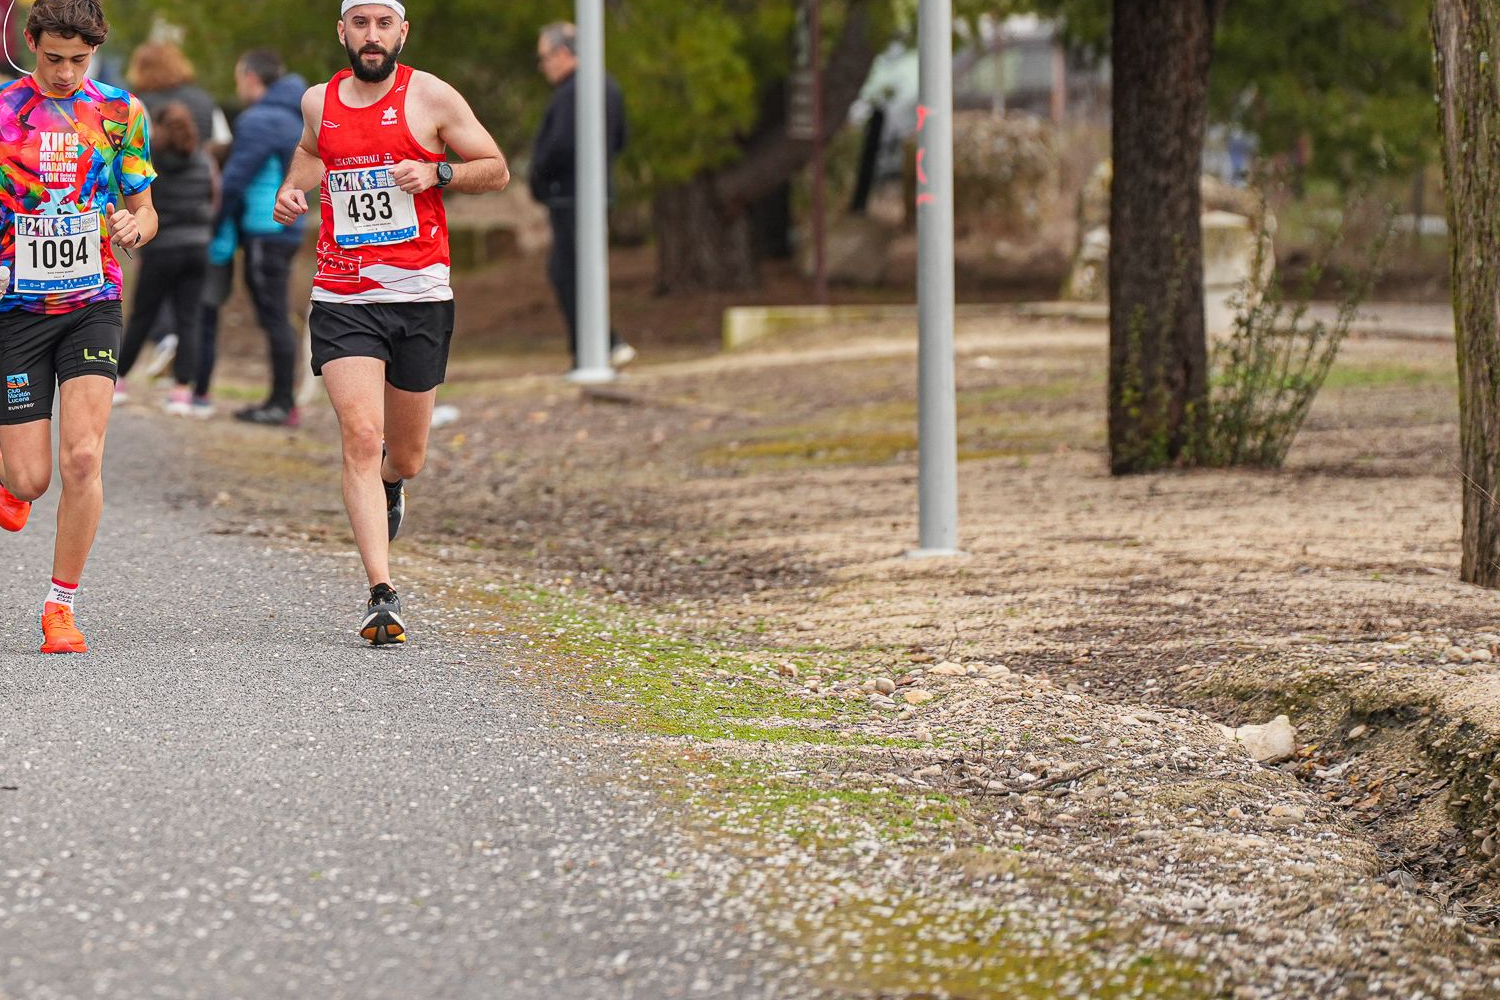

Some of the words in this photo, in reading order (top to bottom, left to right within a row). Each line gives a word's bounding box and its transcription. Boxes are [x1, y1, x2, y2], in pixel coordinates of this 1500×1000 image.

[40, 131, 65, 152] XII
[40, 151, 65, 162] MEDIA
[342, 154, 380, 165] GENERALI
[40, 160, 78, 173] MARATÓN
[45, 172, 60, 183] 10K
[337, 172, 361, 190] 21K
[347, 191, 393, 222] 433
[26, 217, 55, 236] 21K
[28, 236, 89, 269] 1094
